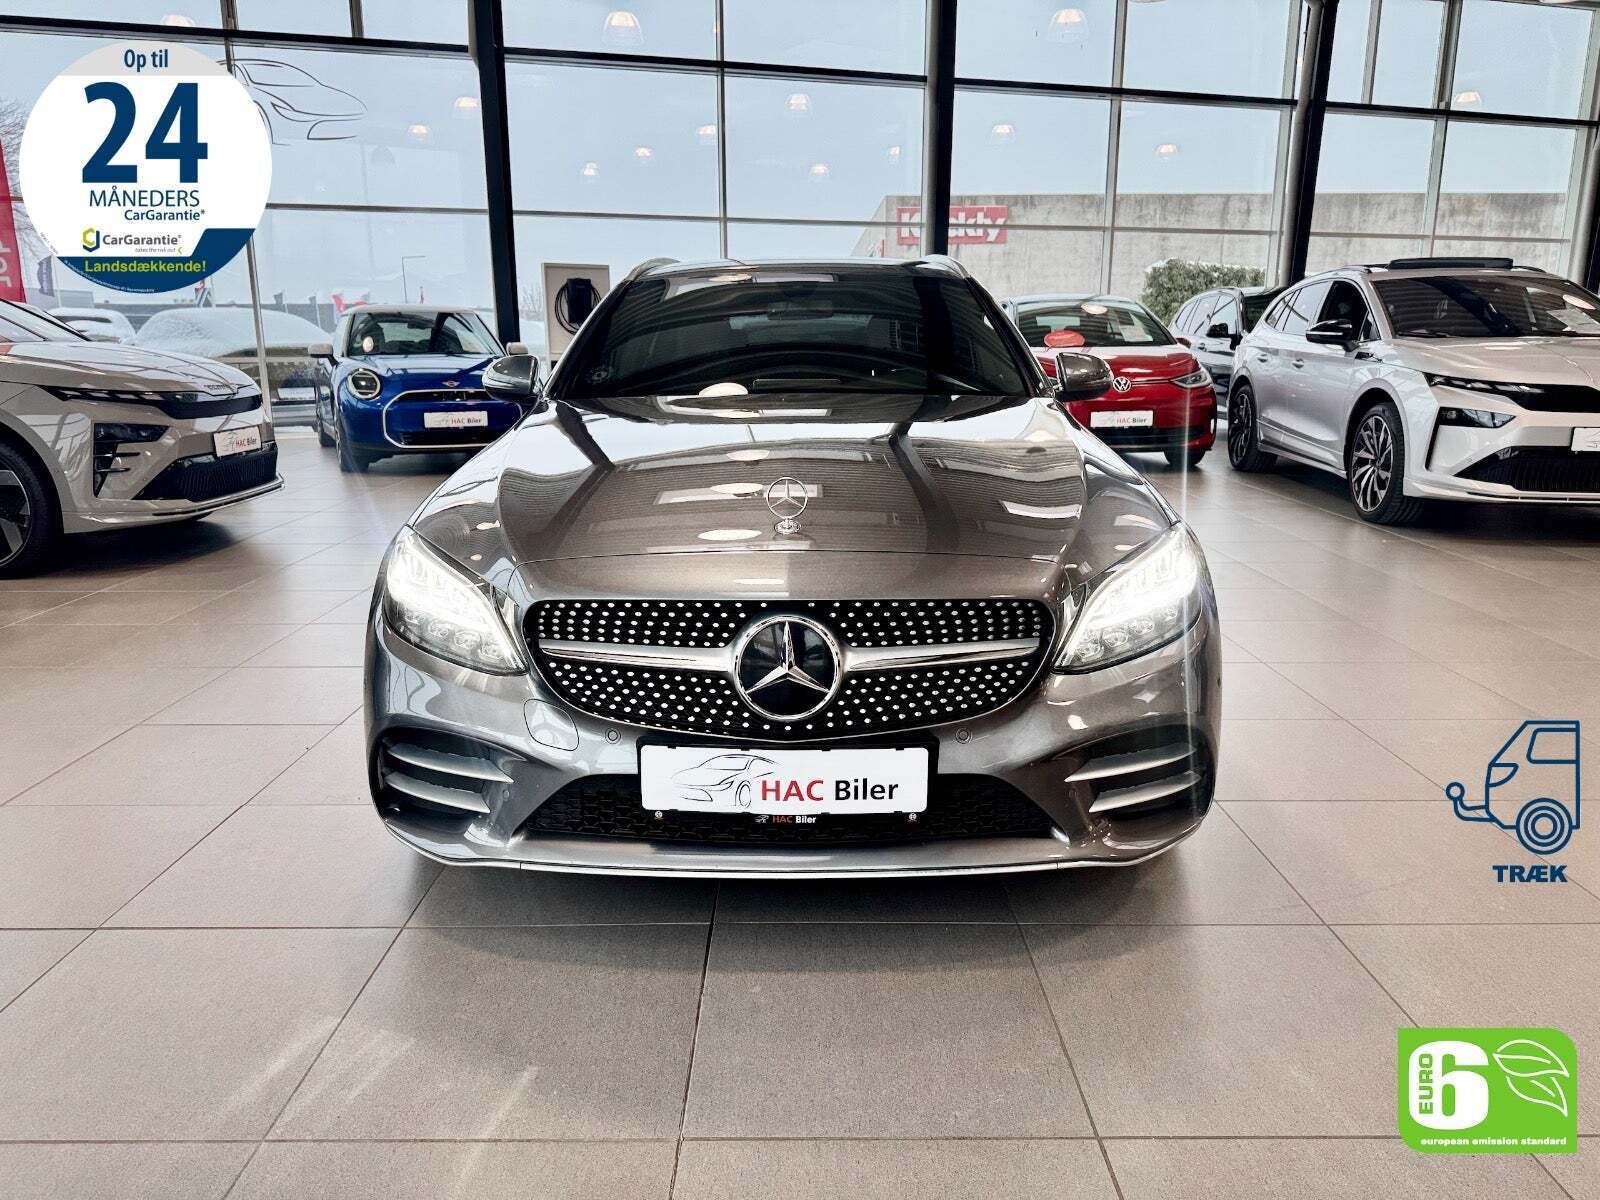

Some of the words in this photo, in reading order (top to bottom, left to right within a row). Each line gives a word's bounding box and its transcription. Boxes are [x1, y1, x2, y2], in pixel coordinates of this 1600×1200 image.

[901, 211, 1006, 242] Kddy
[761, 780, 824, 801] HAC
[835, 778, 899, 800] Biler
[773, 815, 793, 823] HAC
[795, 815, 816, 823] Biler
